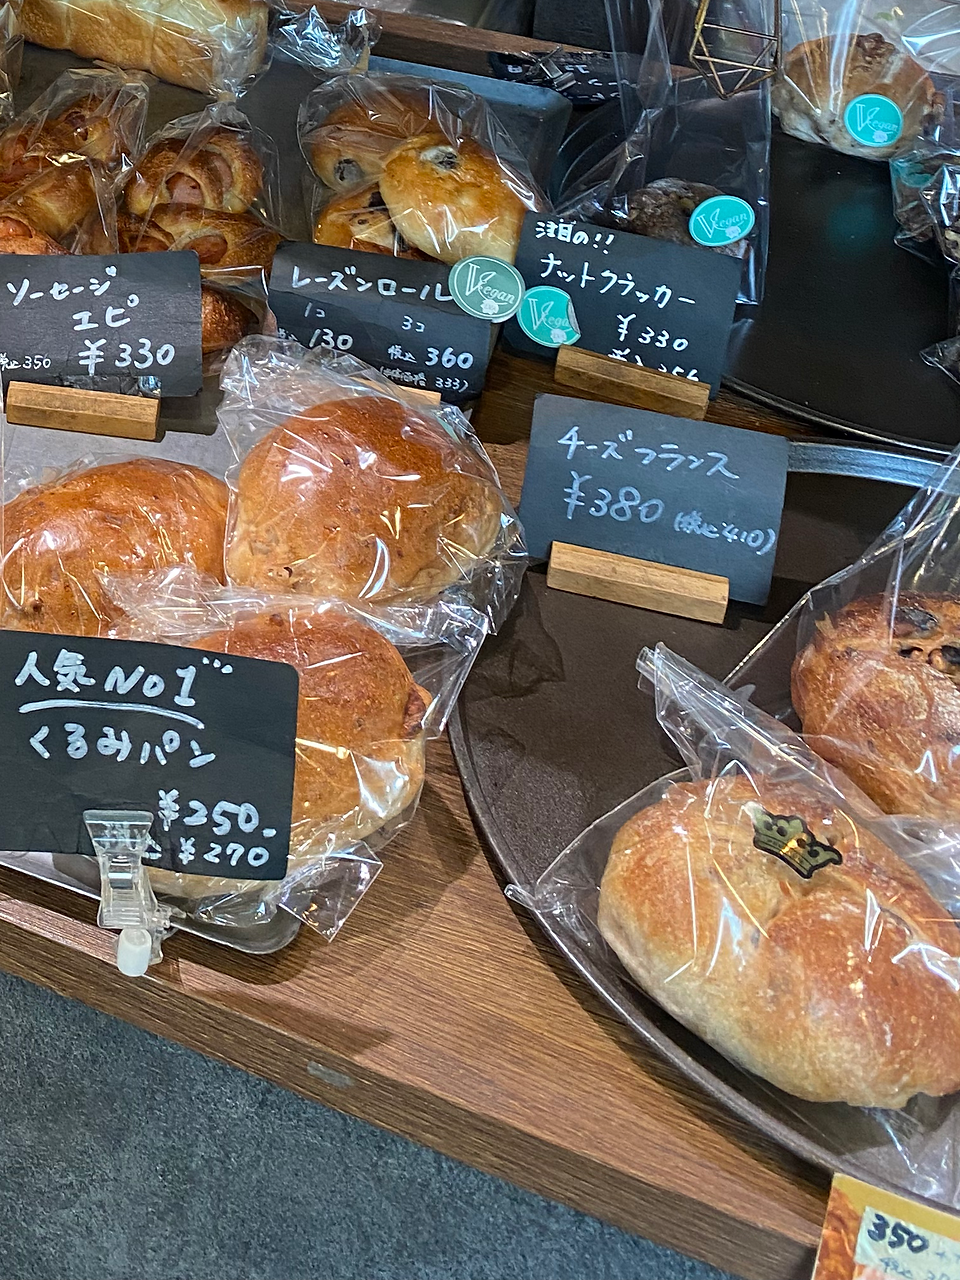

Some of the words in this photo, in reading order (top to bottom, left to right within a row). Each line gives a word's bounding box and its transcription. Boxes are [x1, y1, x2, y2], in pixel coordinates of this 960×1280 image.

[855, 102, 899, 134] Vegan
[695, 207, 748, 240] Vegan
[5, 265, 118, 307] ソーセージ
[291, 264, 454, 303] レーズンロール
[465, 262, 516, 305] Vegan
[539, 252, 697, 310] ナットクラッカー
[71, 293, 140, 332] エピ
[616, 312, 689, 352] ¥330
[77, 337, 176, 377] ¥330
[308, 327, 354, 351] 130
[557, 425, 741, 480] チーズフランス
[562, 470, 666, 524] ¥380
[28, 721, 217, 769] くるみパン
[866, 1212, 930, 1254] 350
